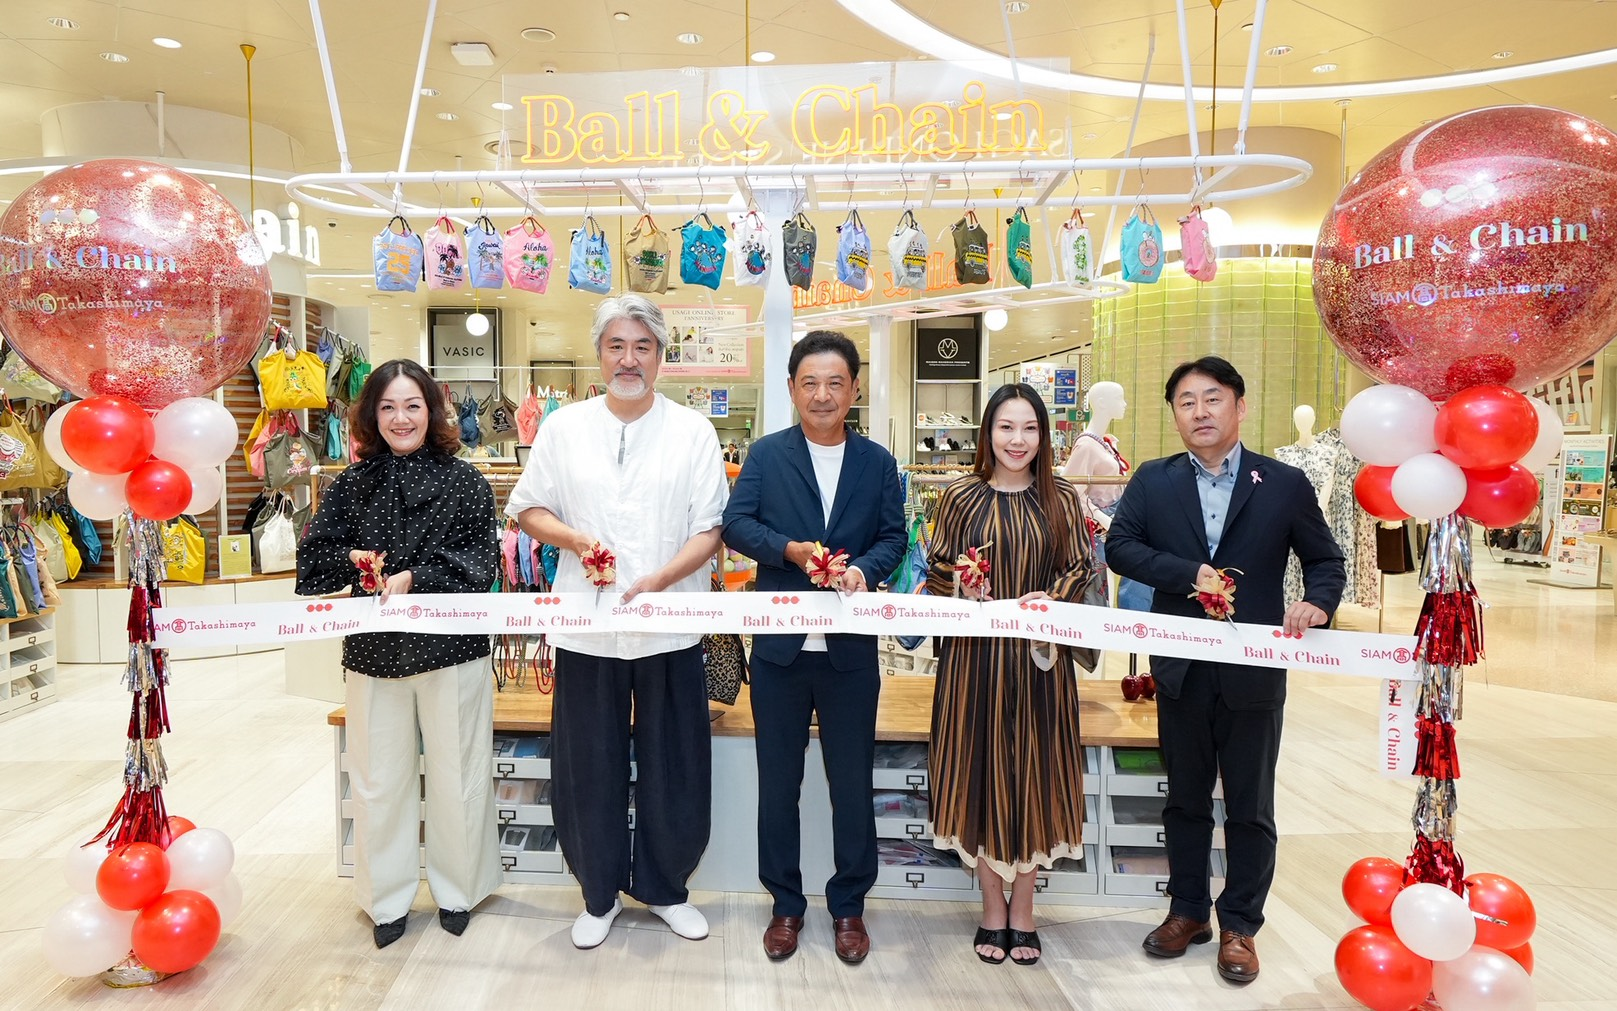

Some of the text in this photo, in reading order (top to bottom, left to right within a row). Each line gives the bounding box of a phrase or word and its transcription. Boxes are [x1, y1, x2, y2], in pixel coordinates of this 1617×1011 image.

[521, 90, 684, 163] Ball
[698, 89, 771, 162] &
[791, 80, 1048, 157] Chain
[253, 202, 321, 266] ain
[1354, 217, 1589, 270] Ball & Chain
[0, 245, 177, 275] all & Chain
[387, 252, 411, 275] 25
[1371, 281, 1567, 305] SIAM Takashimaya
[8, 296, 164, 313] SIAM Takashimaya
[443, 347, 485, 357] VASIC
[380, 608, 488, 620] SIAM Takashimaya
[505, 615, 592, 627] Ball & Chain
[612, 606, 724, 620] SIAM Takashimaya
[743, 615, 833, 627] Ball & Chain
[853, 607, 971, 621] SIAM Takashimaya
[154, 619, 257, 632] AM Takashimaya
[278, 619, 360, 636] Ball & Chain
[990, 617, 1083, 640] Ball & Chain
[1104, 623, 1223, 647] SIAM Takashimaya
[1244, 646, 1341, 666] Ball & Chain
[1360, 648, 1392, 659] SIAM
[1387, 713, 1399, 722] &
[1387, 728, 1401, 770] Chain
